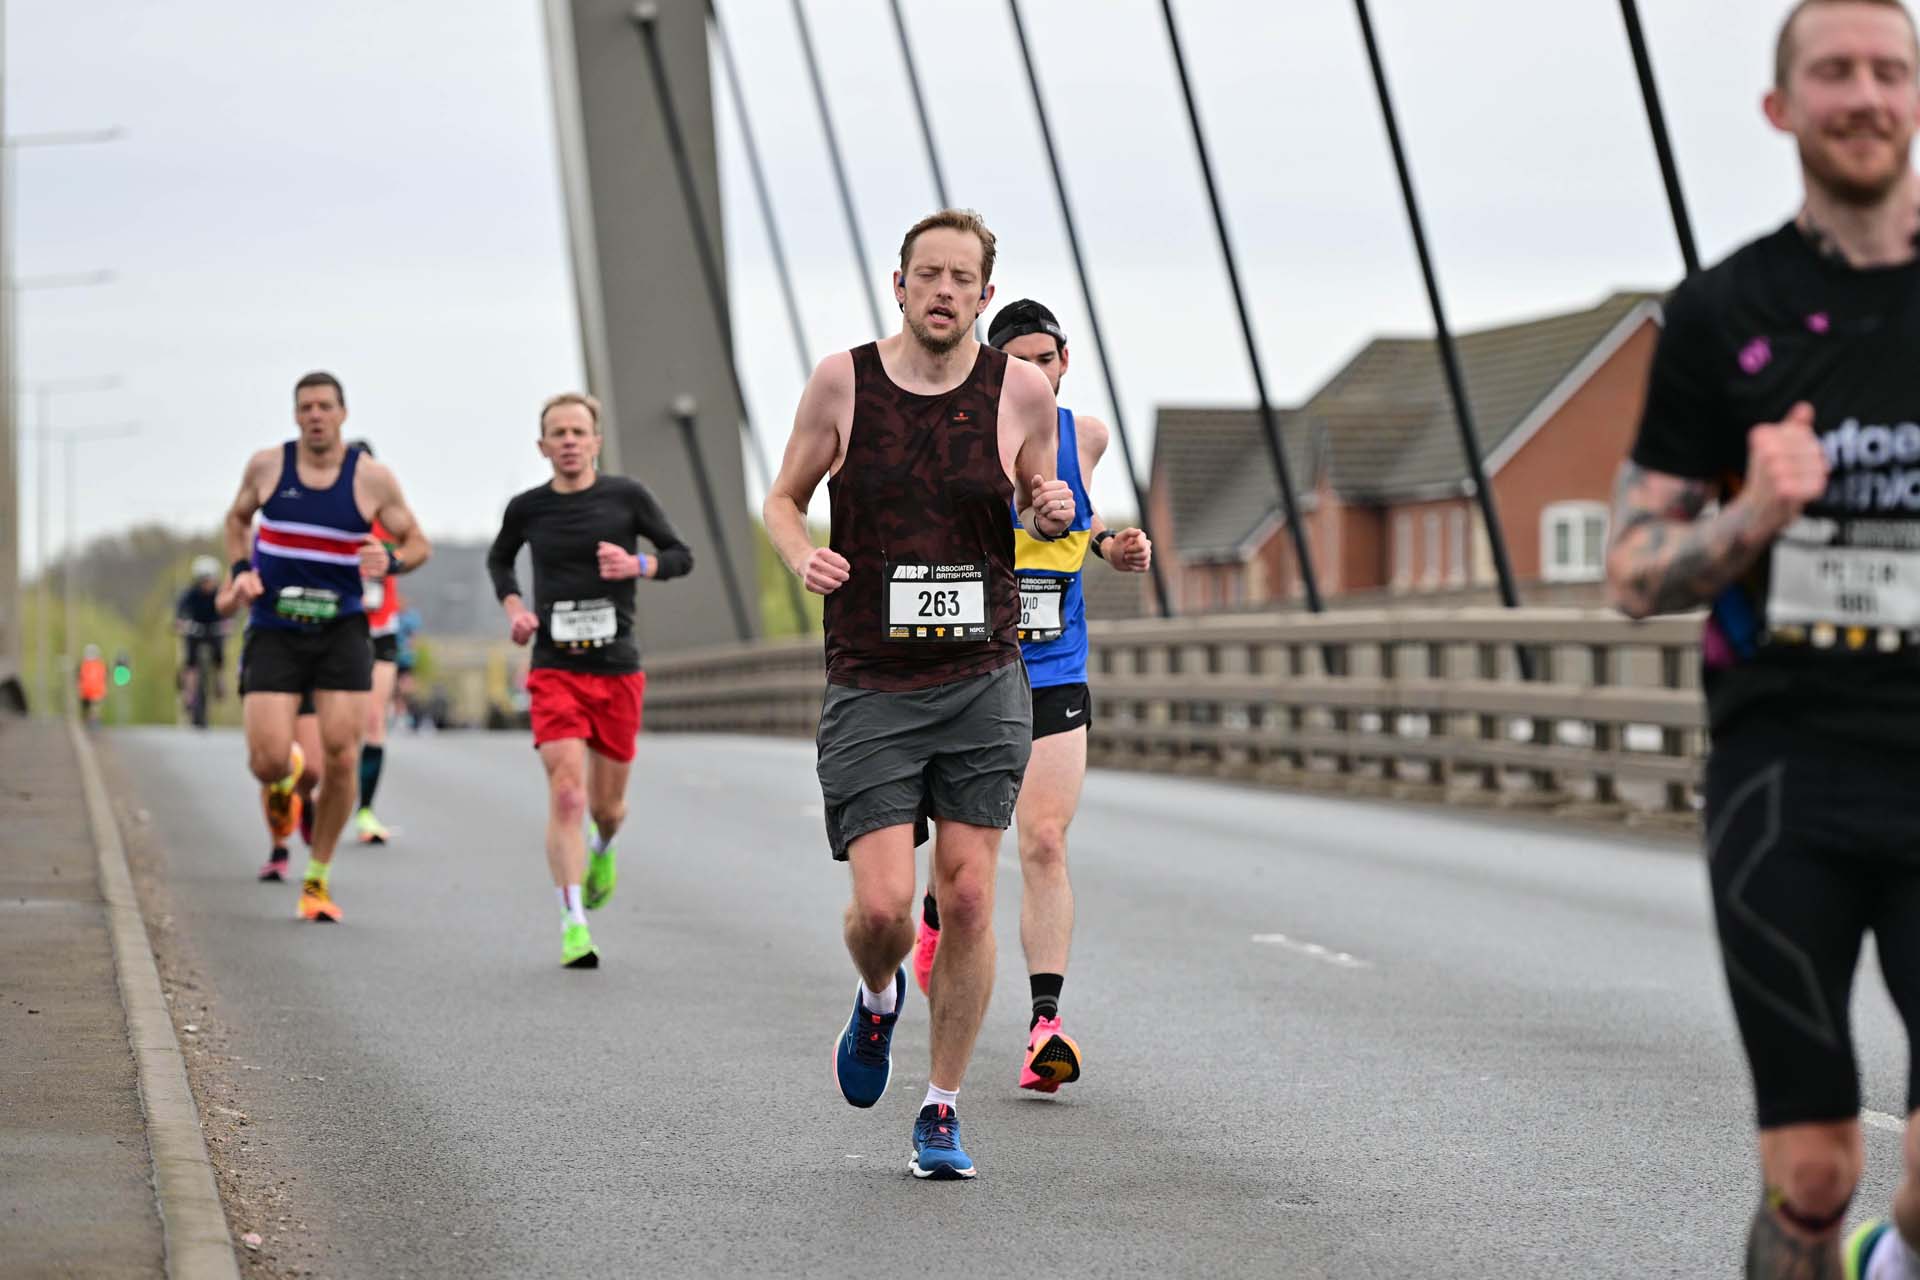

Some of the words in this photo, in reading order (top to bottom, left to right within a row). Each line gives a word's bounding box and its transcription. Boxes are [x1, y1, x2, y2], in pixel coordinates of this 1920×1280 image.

[892, 565, 929, 579] ABP
[918, 590, 961, 617] 263
[1022, 597, 1038, 610] VID
